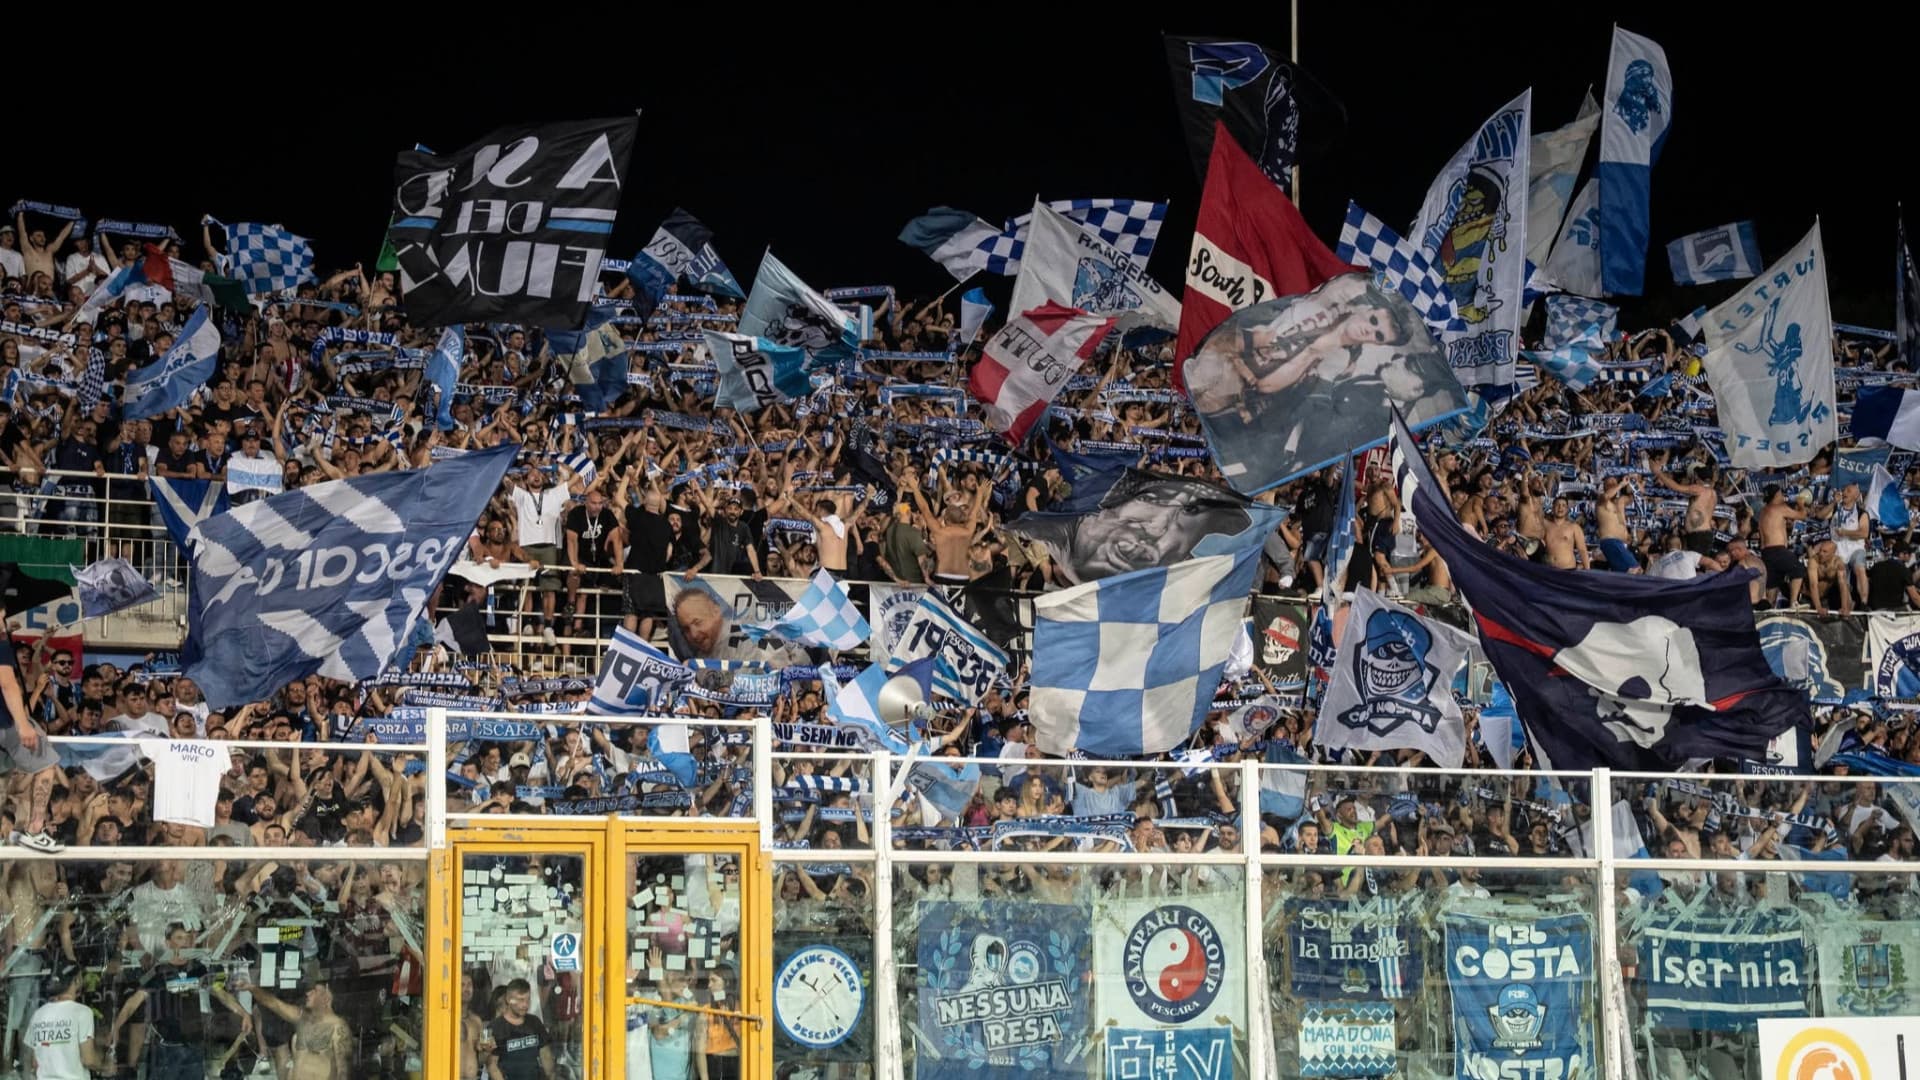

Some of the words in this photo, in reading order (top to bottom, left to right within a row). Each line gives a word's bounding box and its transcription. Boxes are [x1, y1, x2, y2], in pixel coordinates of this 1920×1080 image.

[1078, 232, 1161, 295] RANGERS
[1191, 247, 1245, 306] South
[908, 618, 996, 698] 1936
[170, 742, 215, 759] MARCO
[182, 753, 200, 763] VIVE
[1301, 906, 1353, 931] Solo
[1299, 936, 1321, 959] la
[1330, 936, 1411, 962] maglia
[1488, 923, 1548, 946] 1936
[1126, 908, 1181, 998] CAMPARI
[1187, 914, 1224, 995] GROUP
[1455, 944, 1581, 980] COSTA
[782, 954, 826, 989] WALKING
[828, 957, 857, 993] STICKS
[938, 983, 1067, 1024] NESSUNA
[1150, 999, 1201, 1019] PESCARA
[792, 1022, 844, 1041] PESCARA
[987, 1014, 1059, 1047] RESA
[1304, 1026, 1393, 1044] MARADONA
